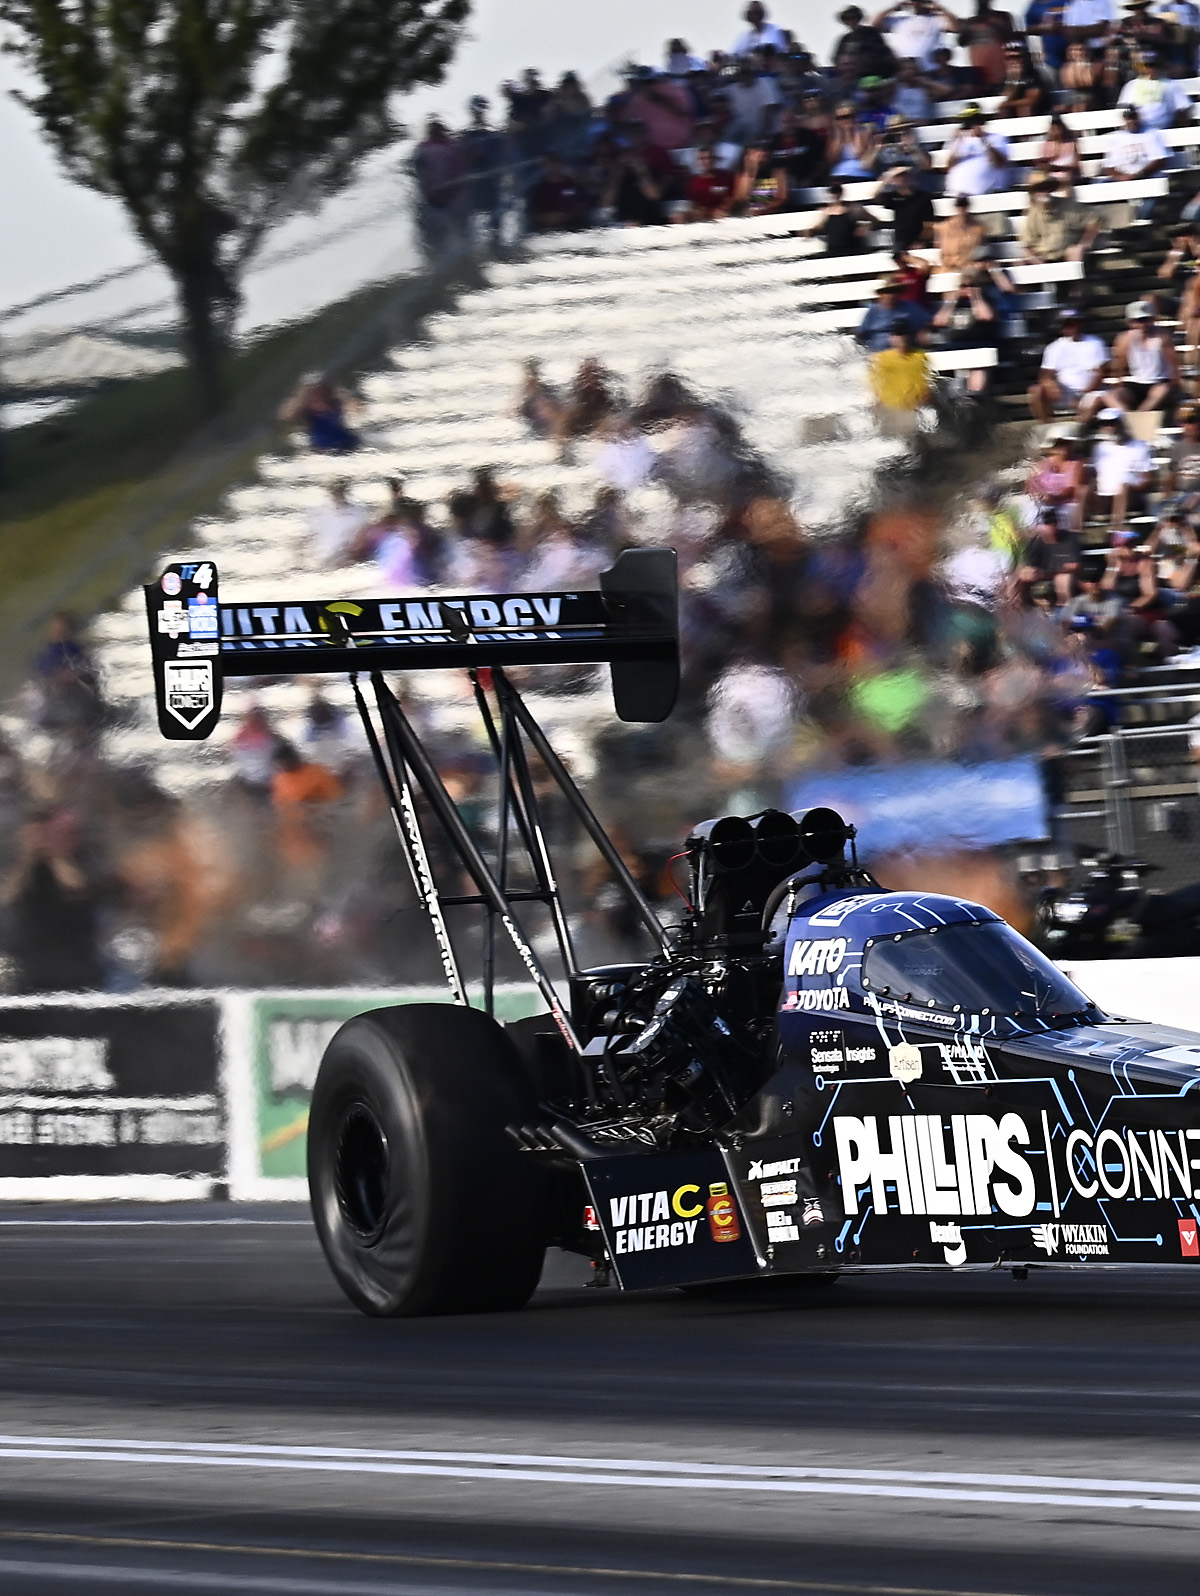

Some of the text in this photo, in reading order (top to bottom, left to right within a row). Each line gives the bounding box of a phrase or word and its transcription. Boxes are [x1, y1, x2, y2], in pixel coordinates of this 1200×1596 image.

[788, 937, 847, 976] KATO
[795, 986, 851, 1011] TOYOTA
[811, 1047, 844, 1064] Sensata
[845, 1046, 876, 1064] Insights
[893, 1057, 920, 1071] Artisan
[833, 1112, 1036, 1217] PHILLIPS
[609, 1190, 671, 1228] VITA
[616, 1219, 699, 1255] ENERGY
[1060, 1223, 1108, 1244] WYAKIN
